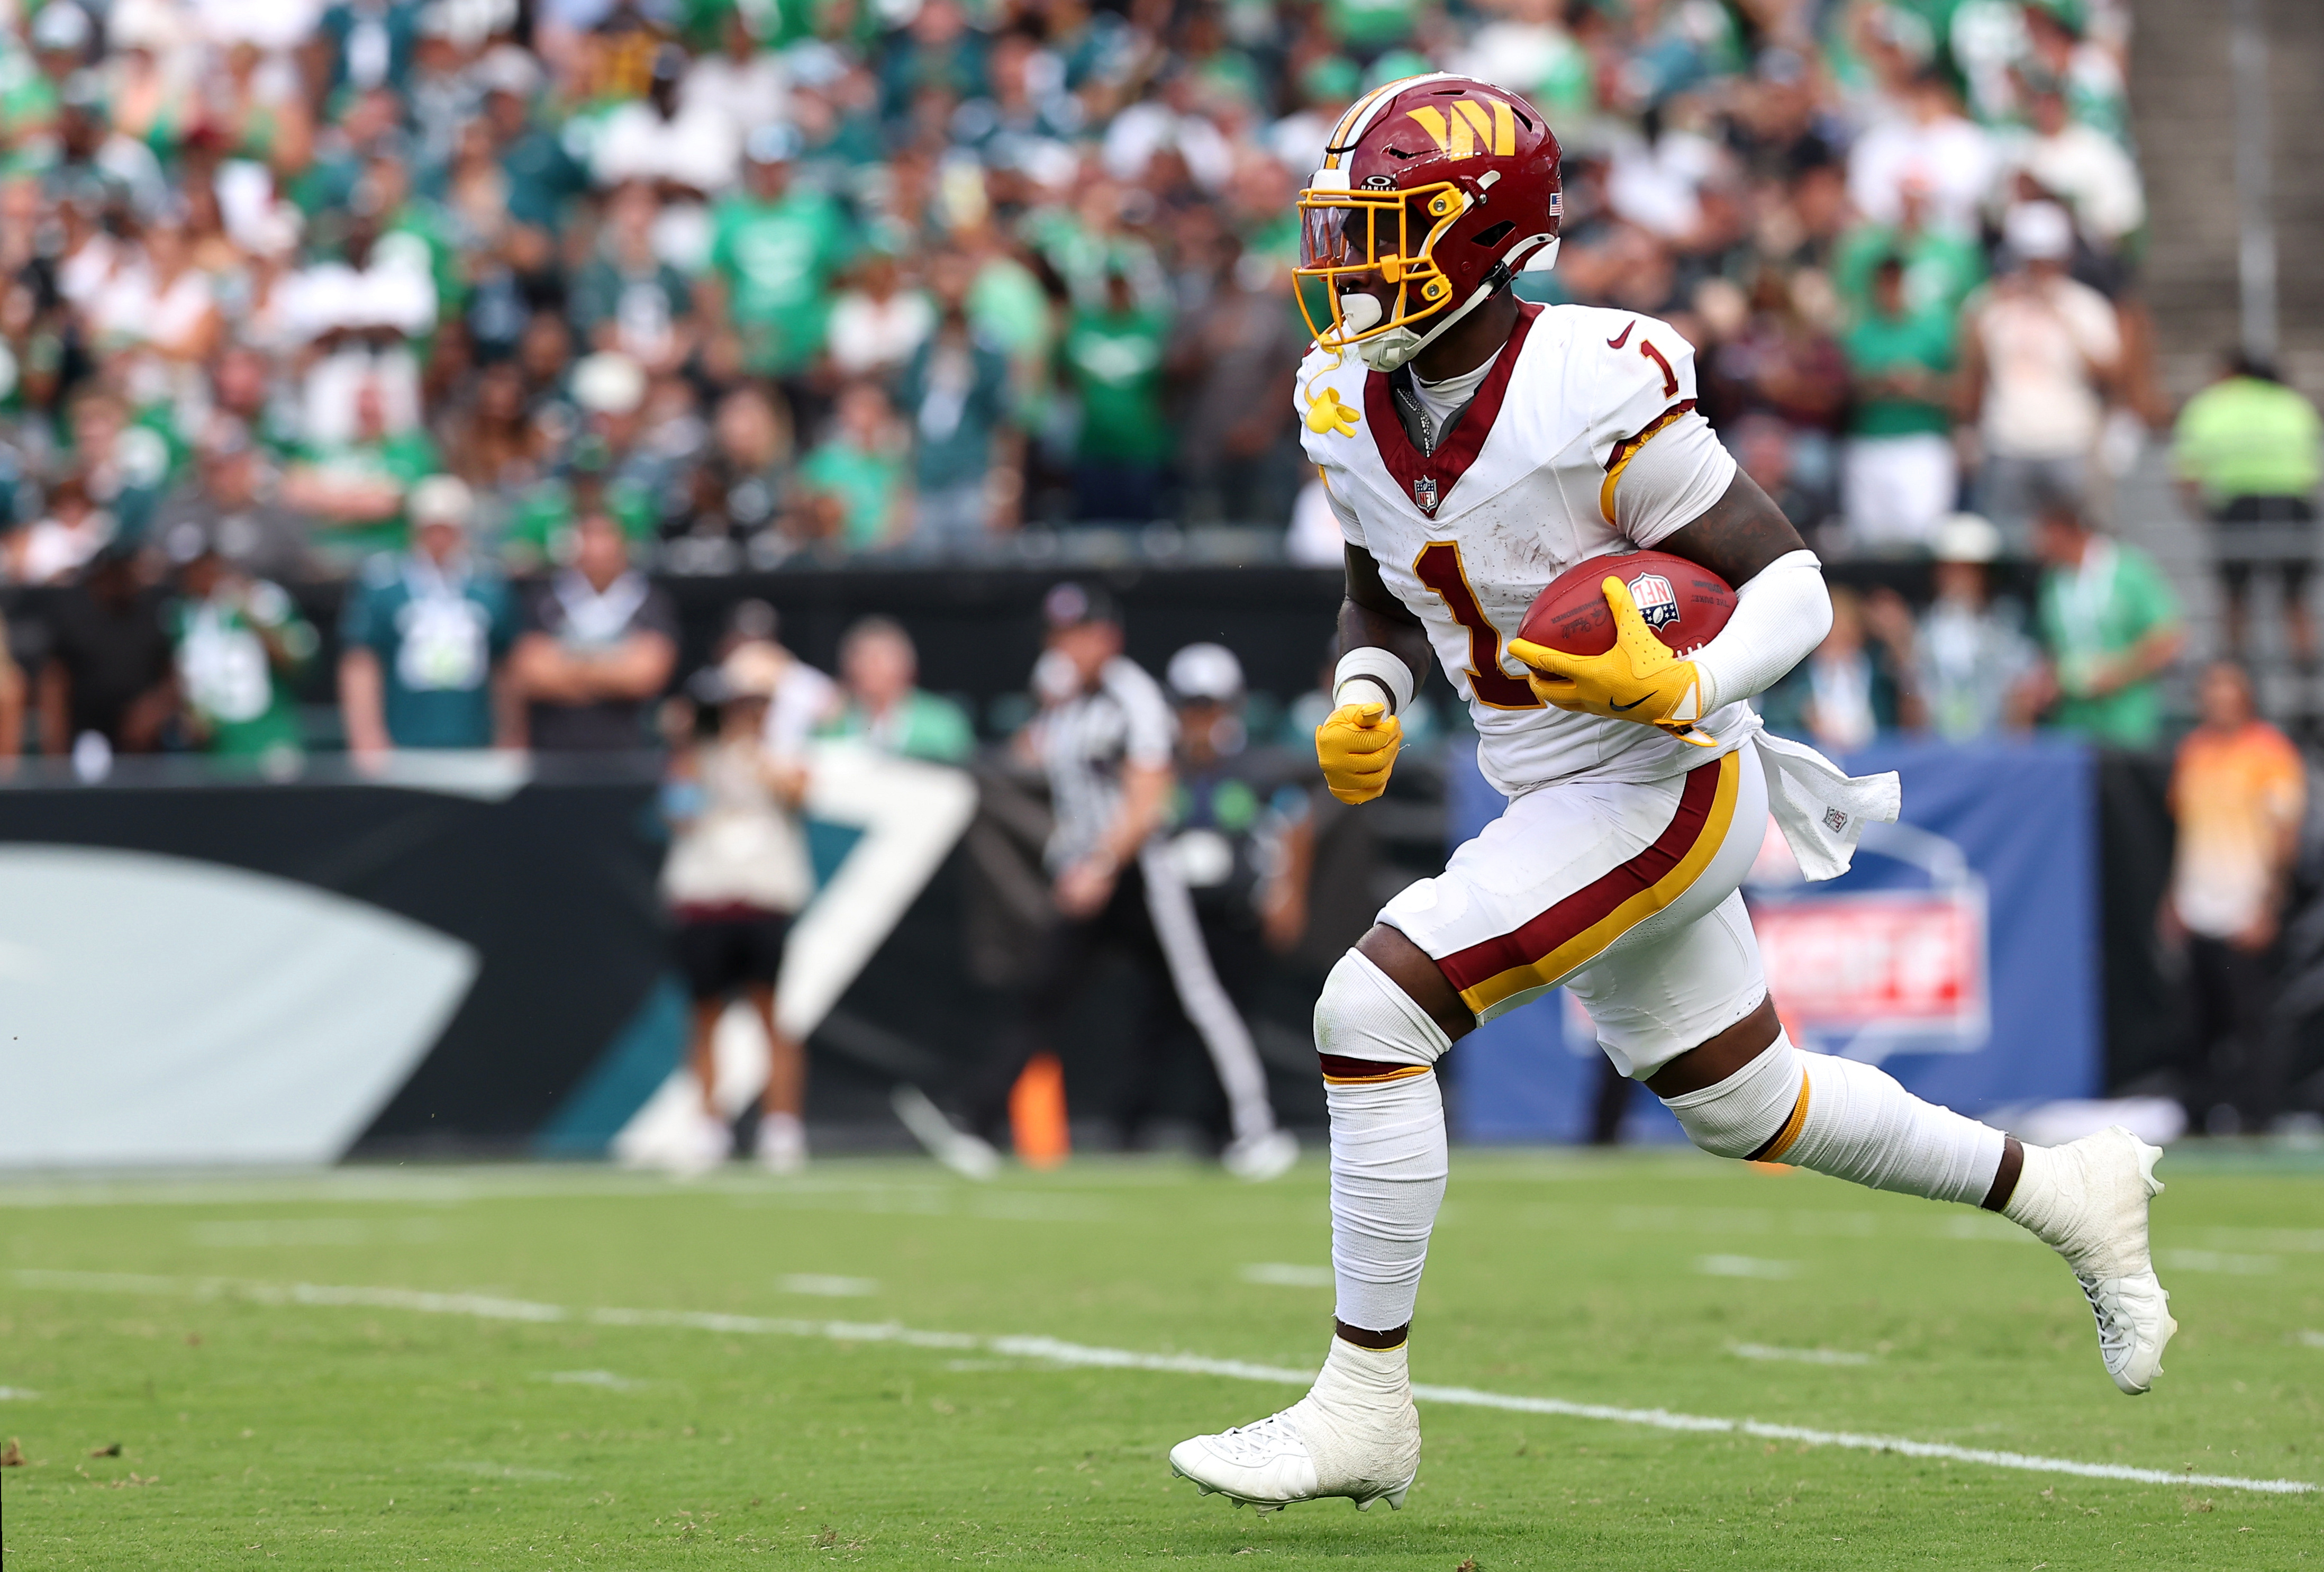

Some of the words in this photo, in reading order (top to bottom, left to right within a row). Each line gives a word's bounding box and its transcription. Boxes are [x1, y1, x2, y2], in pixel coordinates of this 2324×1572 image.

[1639, 338, 1679, 401] 1
[1419, 492, 1435, 506] NFL
[1633, 580, 1671, 606] NFL
[1412, 540, 1547, 710] 1
